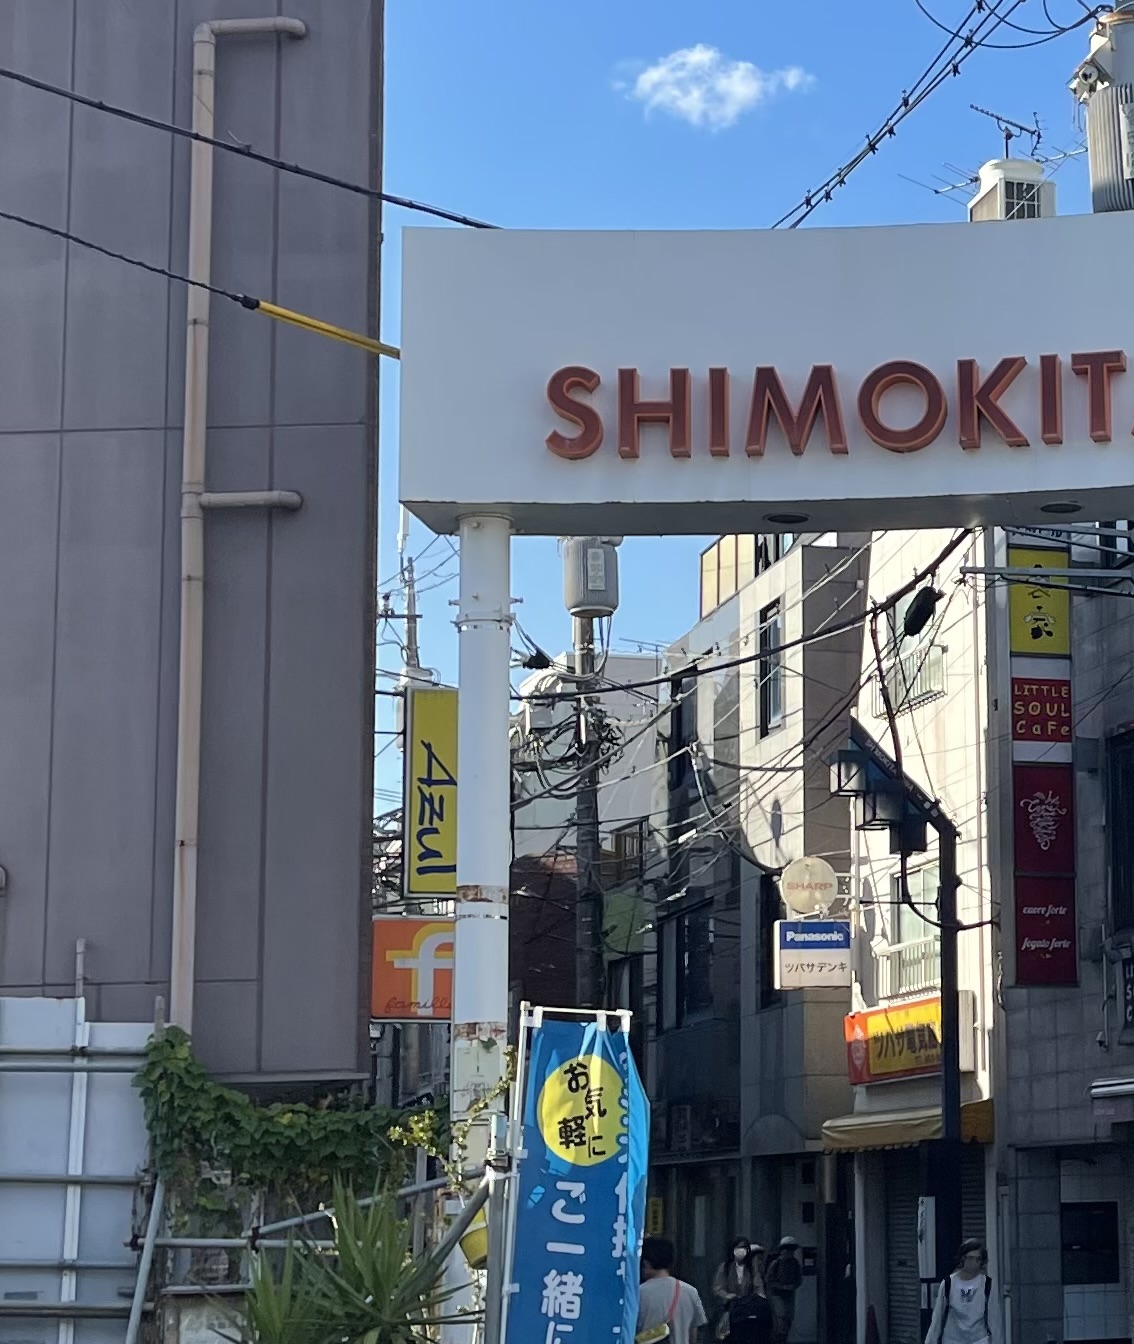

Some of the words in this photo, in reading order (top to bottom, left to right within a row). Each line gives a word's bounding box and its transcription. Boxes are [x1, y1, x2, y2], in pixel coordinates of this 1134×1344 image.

[1014, 683, 1069, 698] LITTLE
[1013, 701, 1070, 717] SOUL
[416, 739, 458, 876] Azul
[786, 881, 833, 891] SHARP
[785, 931, 845, 943] Panasonic
[785, 962, 847, 973] ツバサデンキ
